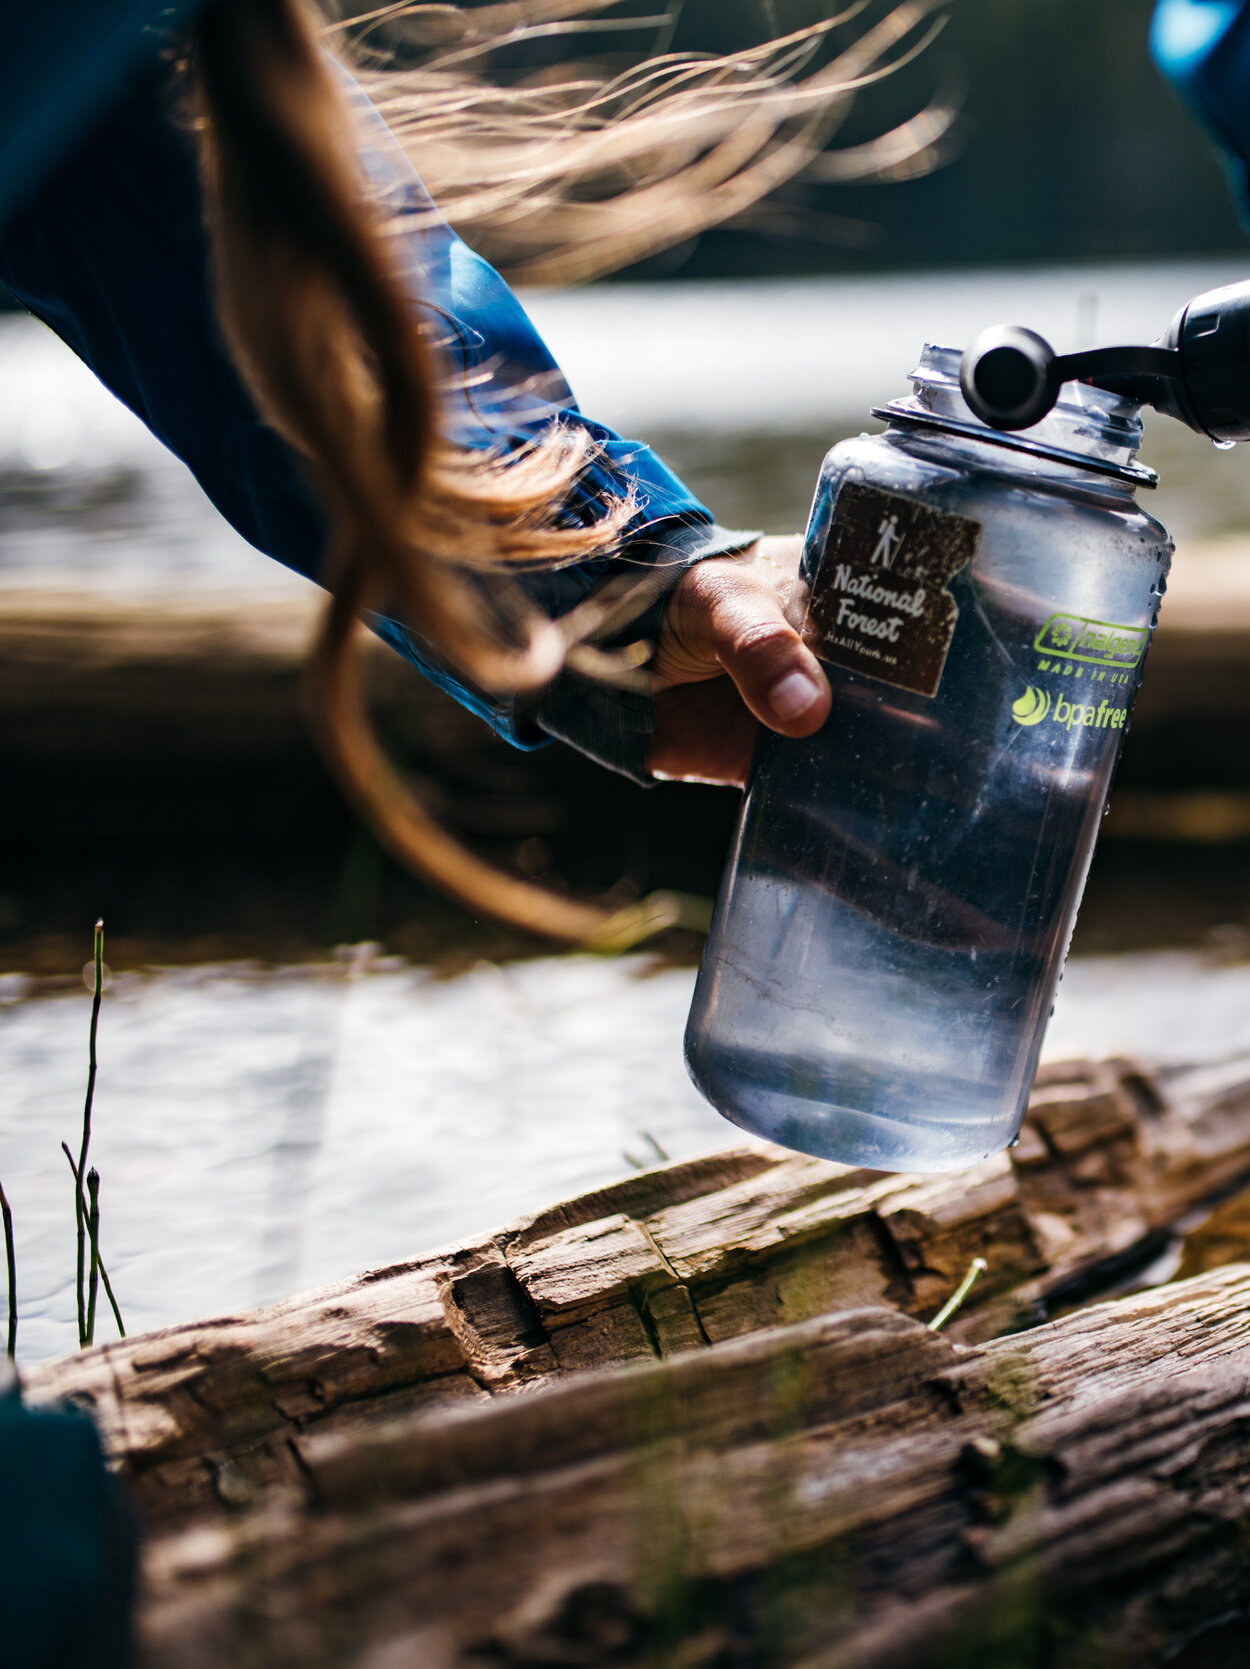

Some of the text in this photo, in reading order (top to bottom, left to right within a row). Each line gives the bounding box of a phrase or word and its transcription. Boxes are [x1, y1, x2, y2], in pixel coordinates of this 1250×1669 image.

[834, 563, 925, 616] National
[837, 599, 904, 642] Forest
[1081, 630, 1142, 658] nalgene
[1038, 660, 1128, 683] MADE IN USA
[1053, 693, 1127, 730] bpafree
